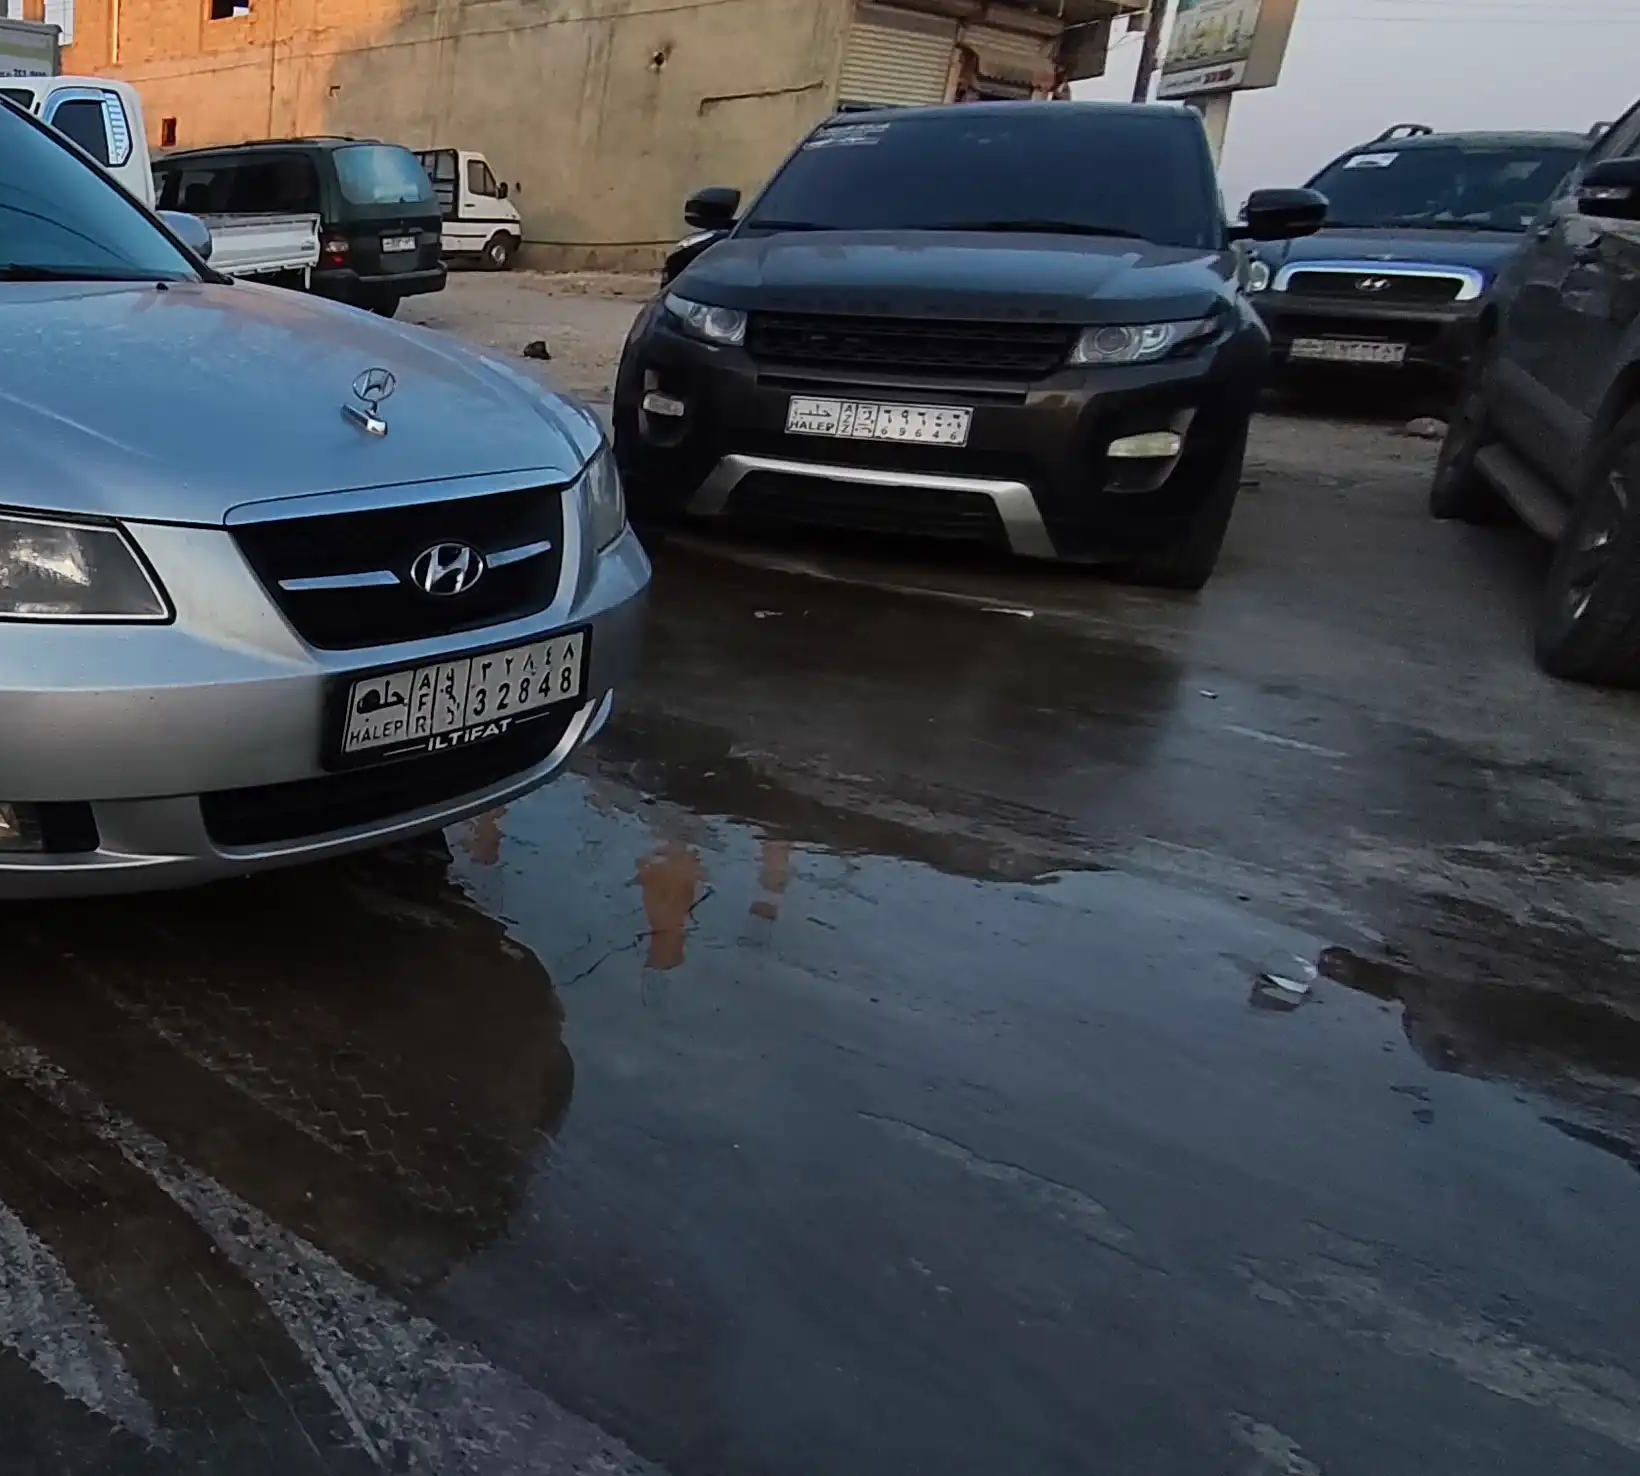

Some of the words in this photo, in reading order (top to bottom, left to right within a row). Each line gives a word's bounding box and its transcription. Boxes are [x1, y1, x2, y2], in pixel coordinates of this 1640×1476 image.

[789, 419, 835, 432] HALEP
[415, 672, 431, 734] AFR
[473, 665, 572, 717] 32848
[349, 718, 404, 747] HALEP
